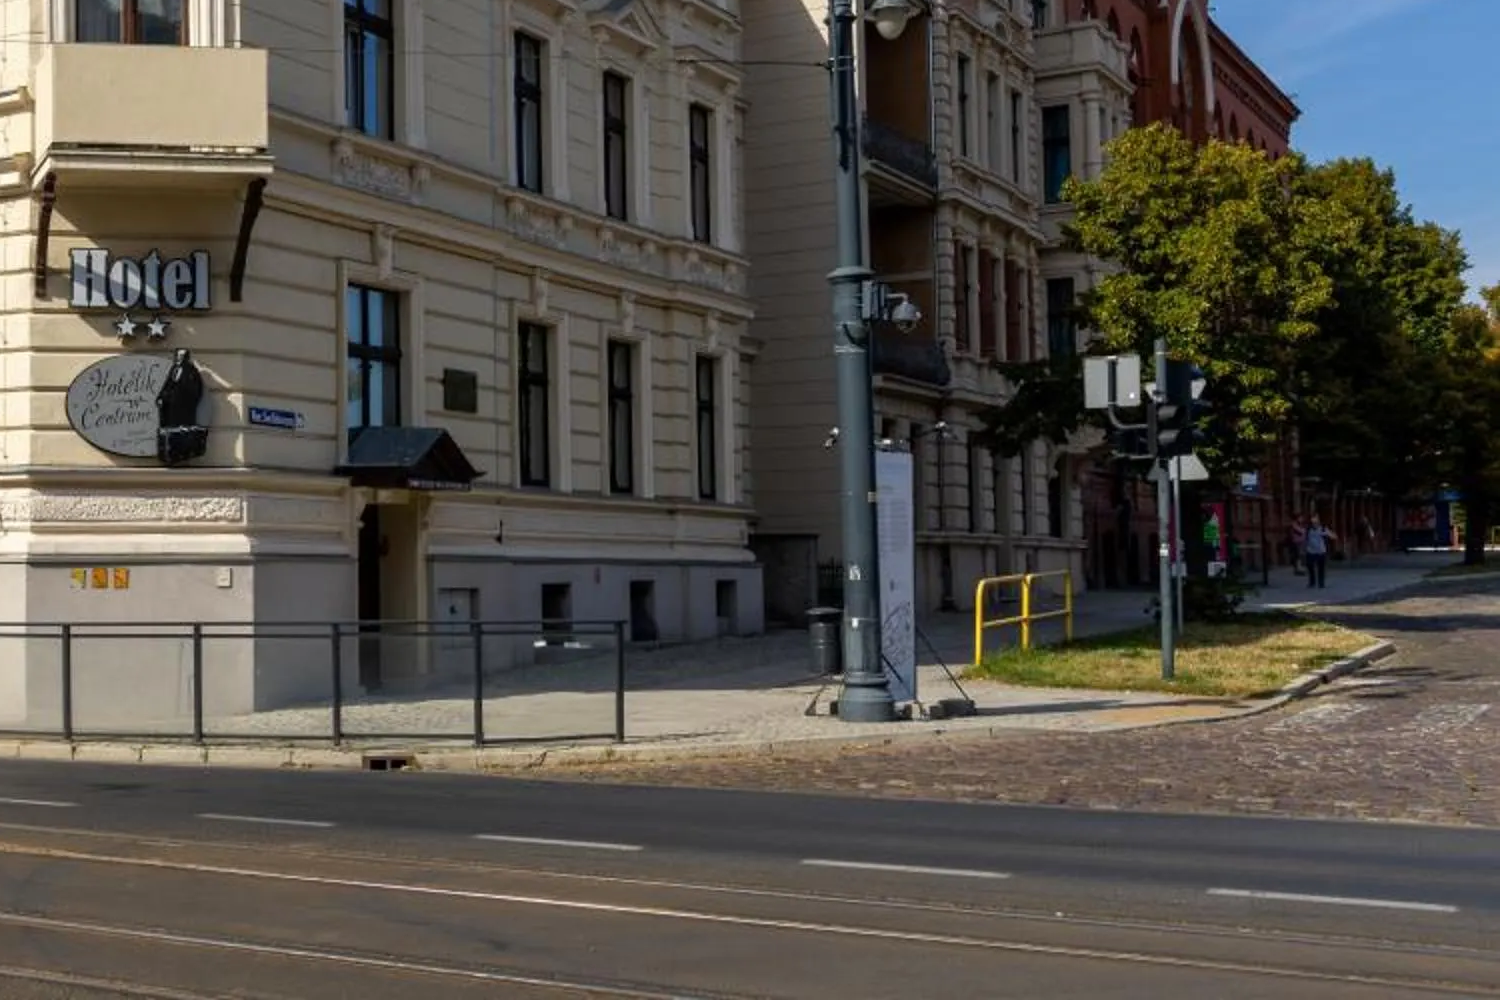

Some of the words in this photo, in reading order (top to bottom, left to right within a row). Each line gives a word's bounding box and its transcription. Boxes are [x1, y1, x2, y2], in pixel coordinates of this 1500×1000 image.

[69, 248, 211, 309] Hotel
[87, 363, 160, 400] Hotelik
[81, 402, 152, 430] Centrum
